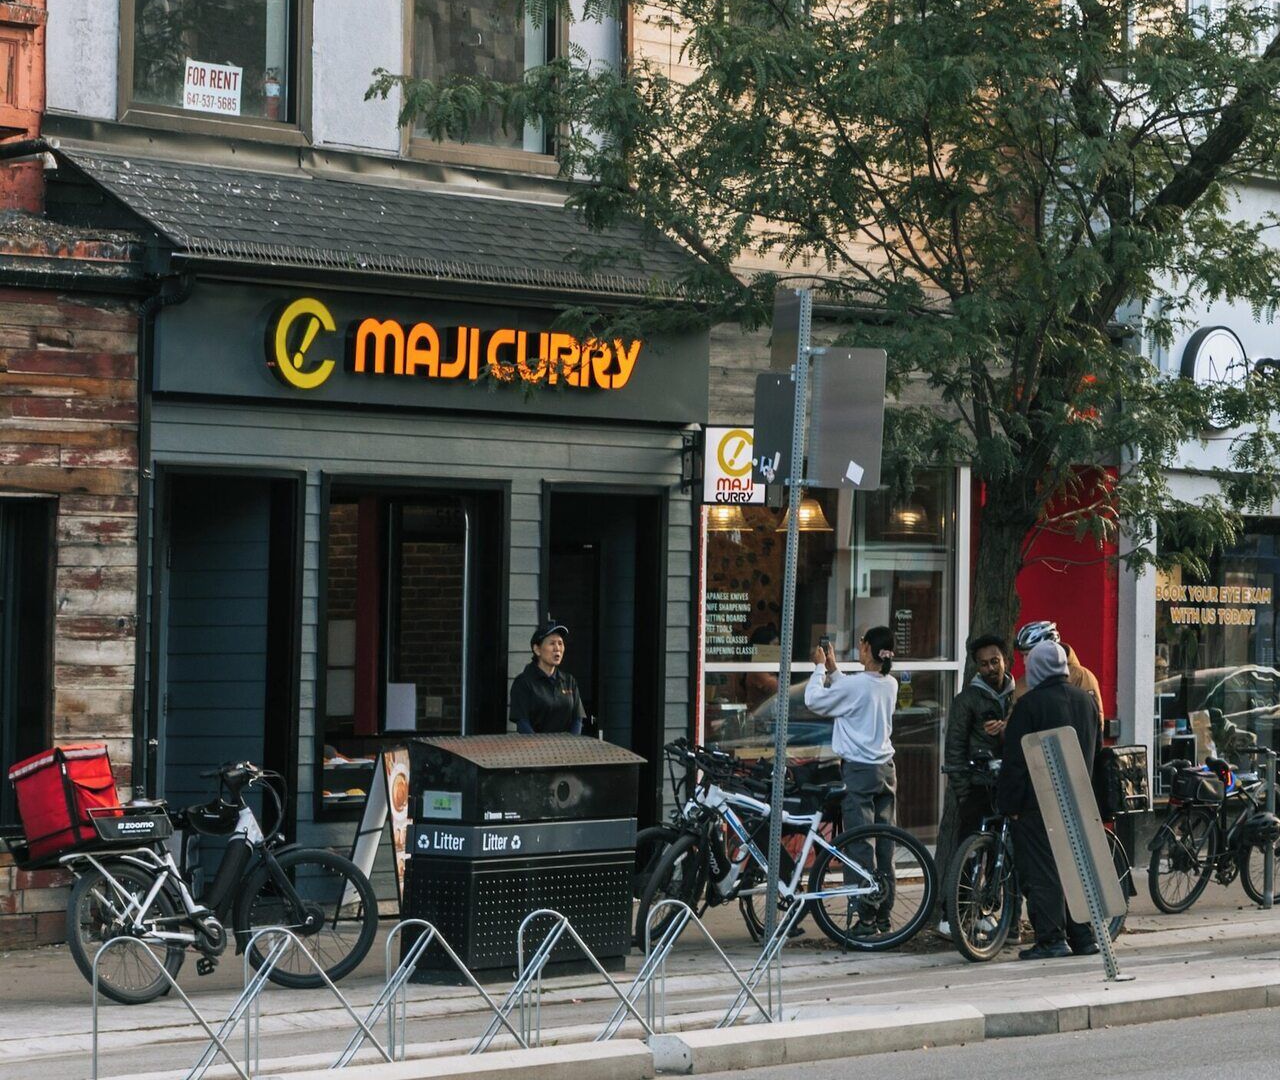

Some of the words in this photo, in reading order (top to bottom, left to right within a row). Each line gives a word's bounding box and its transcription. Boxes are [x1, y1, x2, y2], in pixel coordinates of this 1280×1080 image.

[187, 66, 206, 87] FOR
[210, 69, 239, 91] RENT
[186, 92, 237, 111] 647-537-5685
[717, 478, 753, 491] MAJI
[715, 492, 754, 503] CURRY
[706, 592, 729, 600] APANESE
[730, 592, 749, 601] KNIVES
[1156, 585, 1187, 601] BOOK
[1188, 585, 1218, 602] YOUR
[1220, 586, 1240, 603] EYE
[1241, 587, 1271, 604] EXAM
[706, 603, 718, 611] NIFE
[719, 603, 751, 612] SHARPENING
[706, 614, 725, 622] UTTING
[726, 614, 747, 622] BOARDS
[1170, 607, 1200, 624] WITH
[1201, 607, 1216, 624] US
[1218, 608, 1255, 625] TODAY!
[726, 635, 748, 644] CLASSES
[736, 646, 758, 655] CLASSES
[434, 831, 465, 850] Litter
[483, 833, 508, 851] Litter
